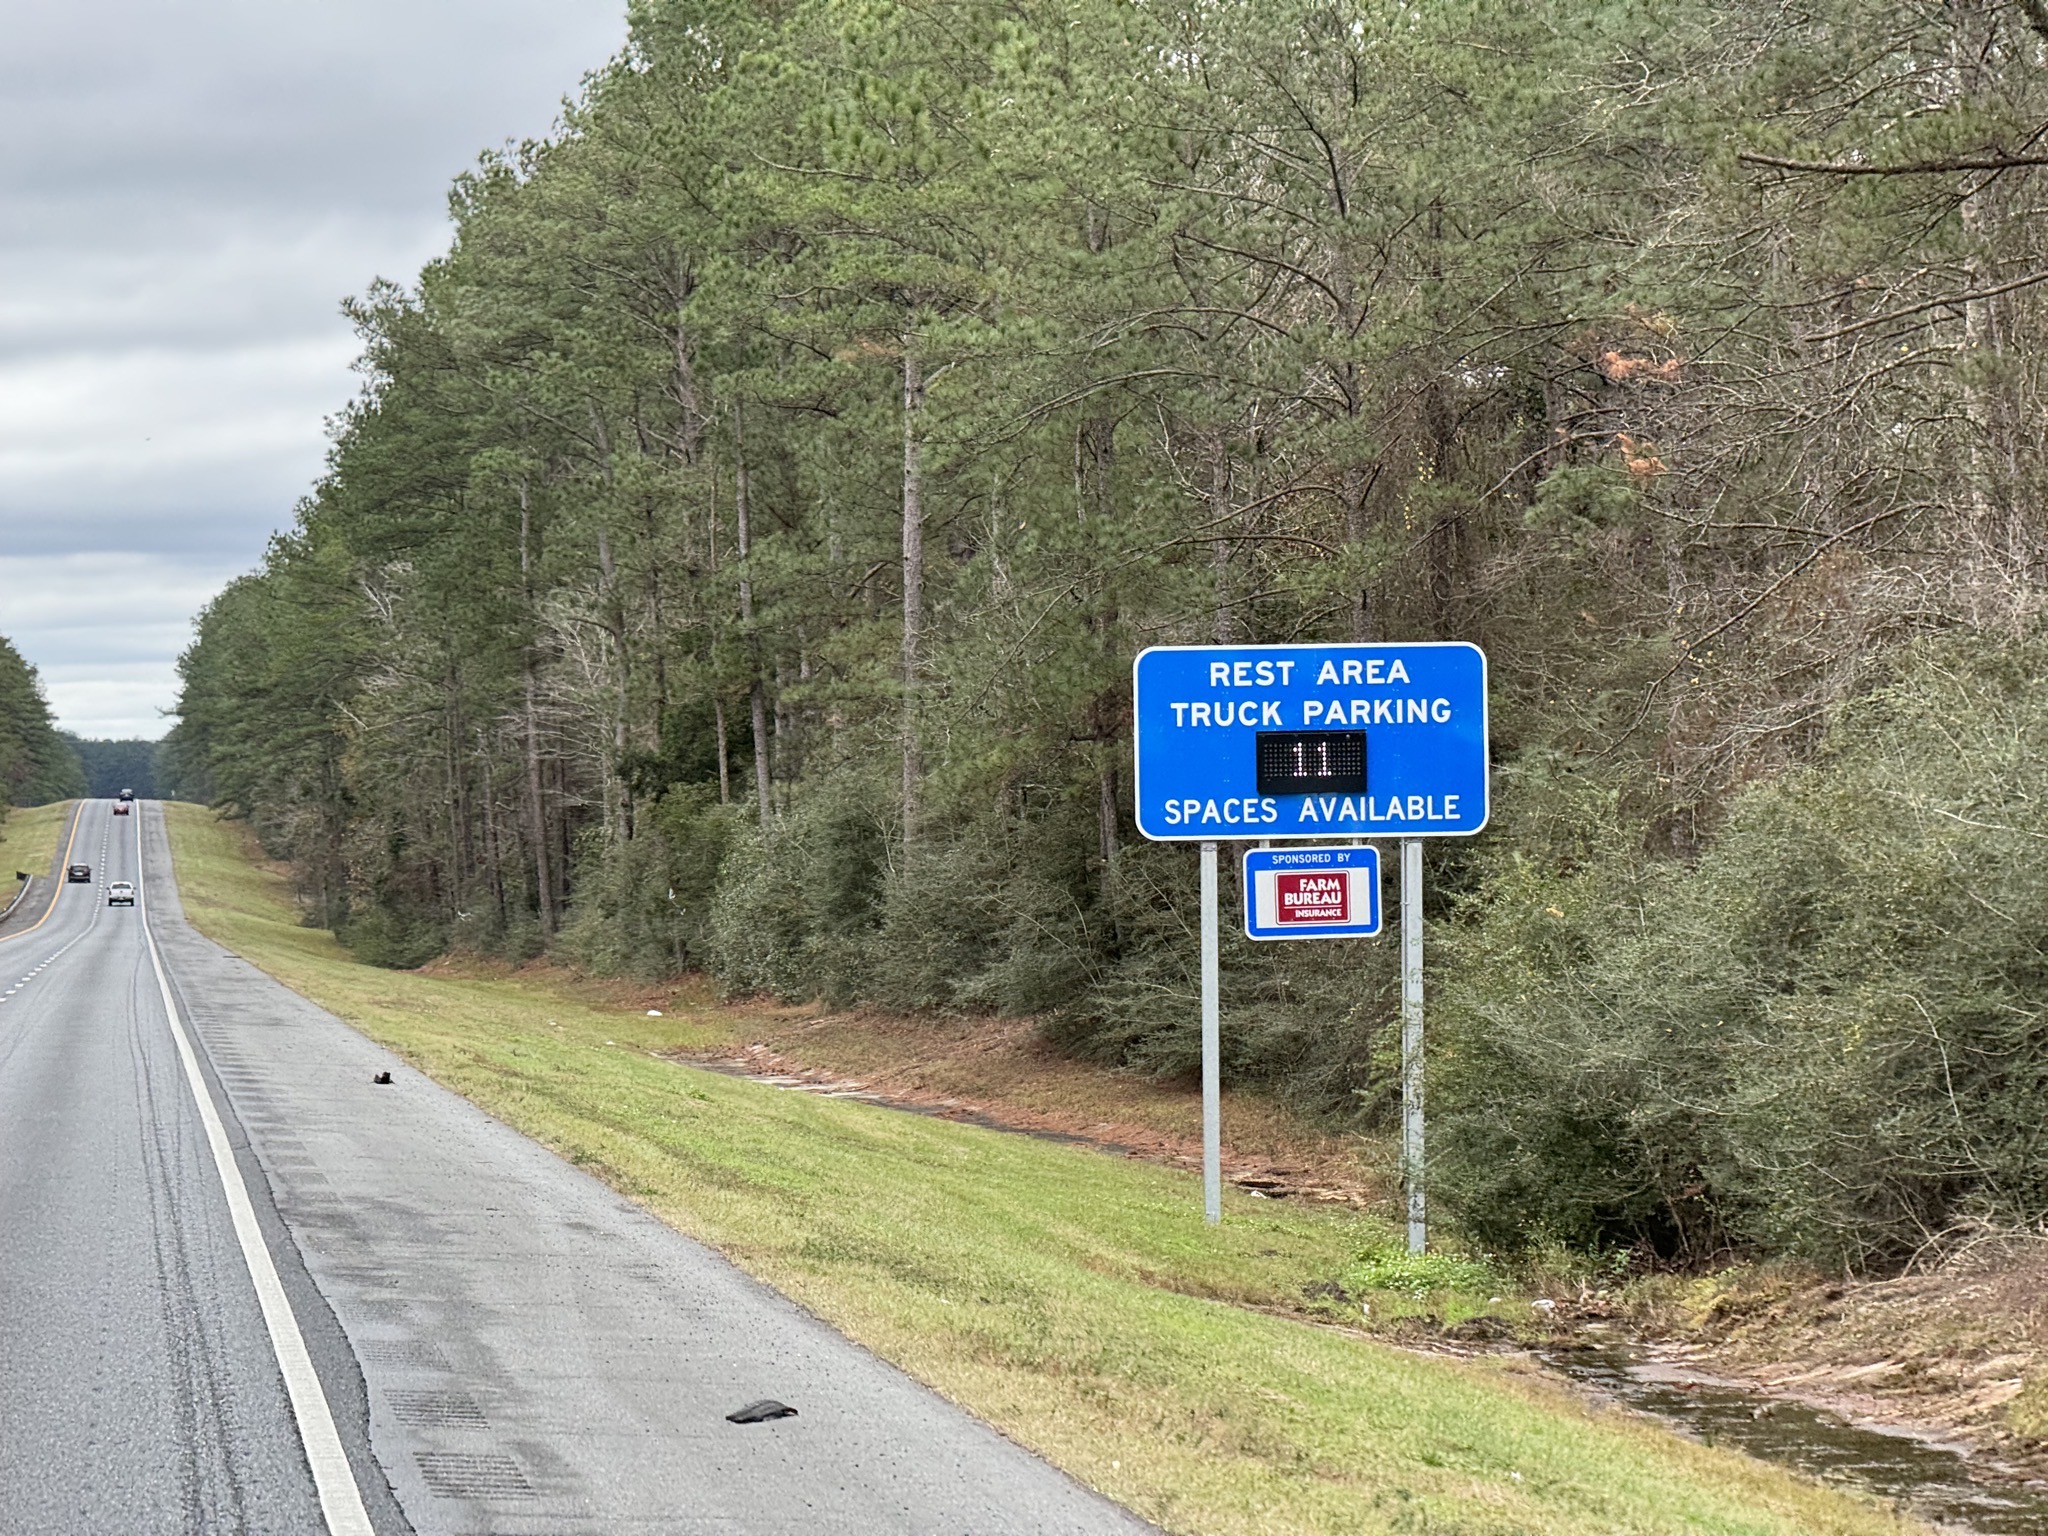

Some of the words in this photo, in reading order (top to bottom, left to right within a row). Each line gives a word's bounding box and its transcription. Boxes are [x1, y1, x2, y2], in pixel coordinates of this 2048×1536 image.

[1210, 661, 1295, 687] REST
[1317, 659, 1410, 685] AREA
[1171, 701, 1282, 727] TRUCK
[1304, 698, 1451, 724] PARKING
[1293, 742, 1331, 777] 11
[1164, 799, 1278, 824] SPACES
[1299, 795, 1460, 822] AVAILABLE
[1272, 854, 1331, 864] SPONSORED
[1337, 853, 1350, 863] BY
[1300, 878, 1340, 891] FARM
[1285, 891, 1341, 905] BUREAU
[1296, 908, 1341, 917] INSURANCE
